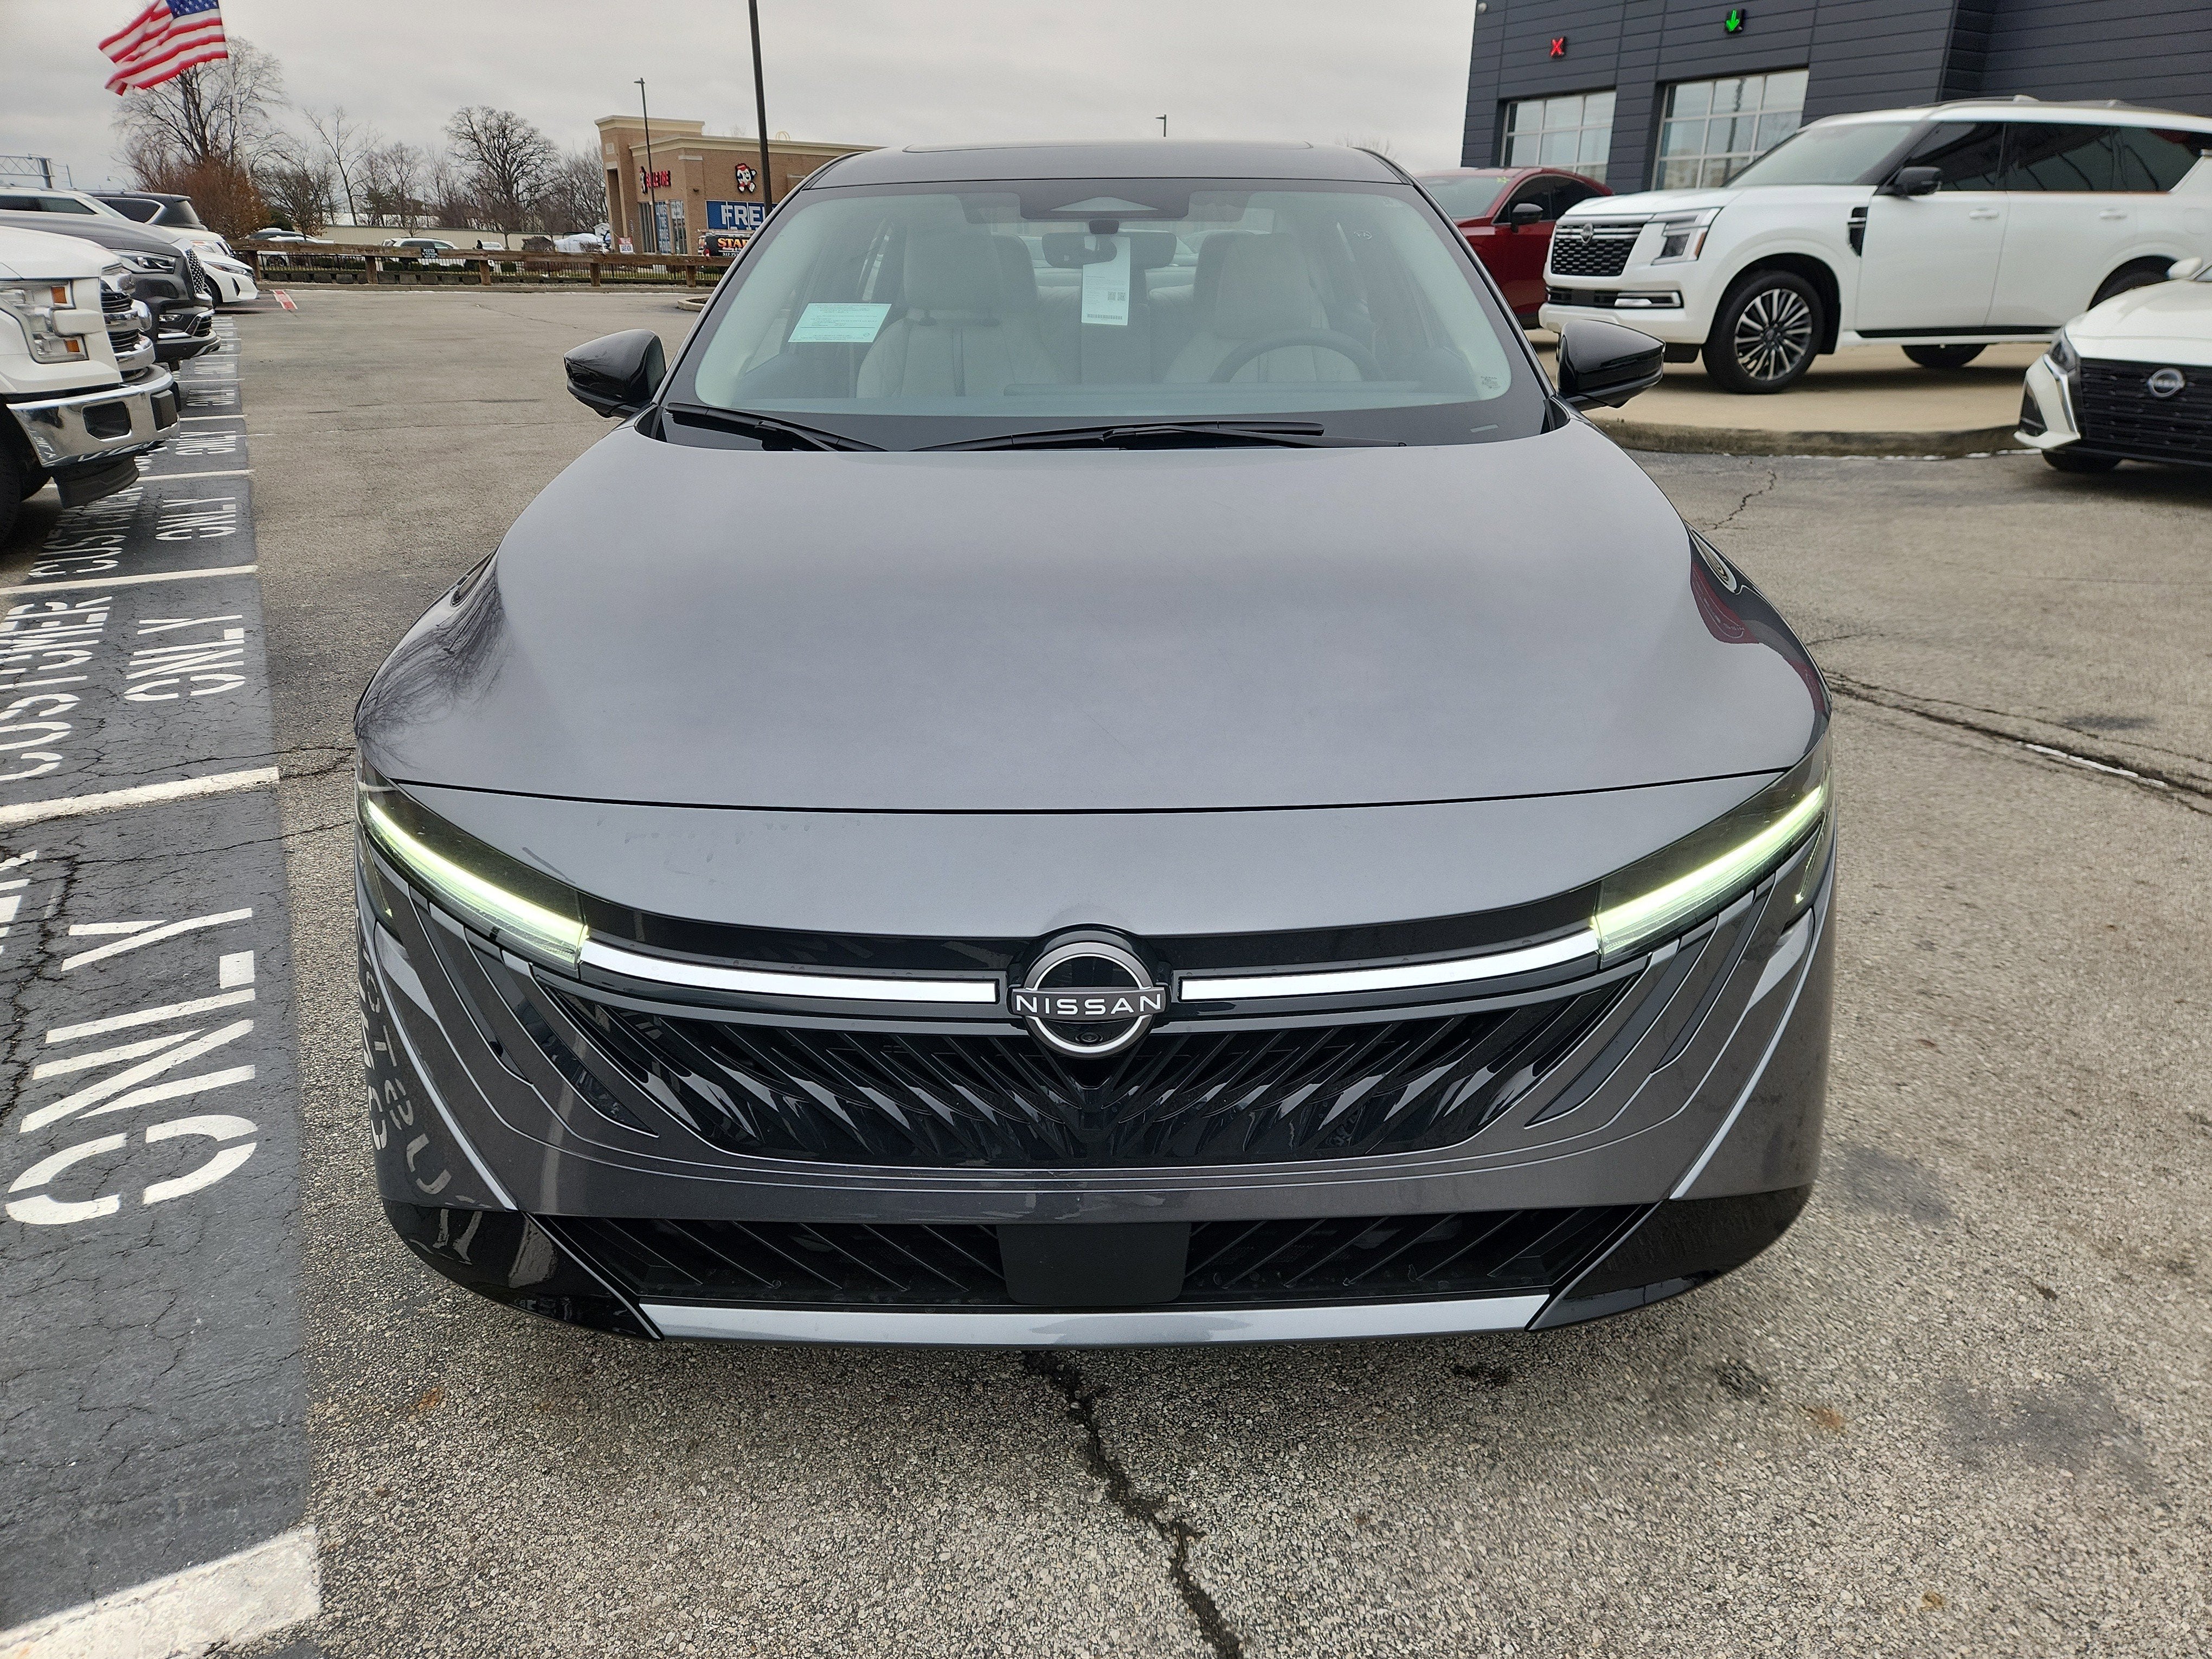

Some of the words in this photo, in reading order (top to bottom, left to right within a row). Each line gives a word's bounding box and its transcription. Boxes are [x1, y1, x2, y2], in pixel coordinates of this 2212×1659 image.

[186, 389, 235, 406] ONLY
[175, 431, 236, 455] ONLY
[155, 497, 236, 541] ONLY
[124, 614, 246, 702] ONLY
[1016, 993, 1161, 1015] NISSAN
[5, 907, 259, 1225] ONLY
